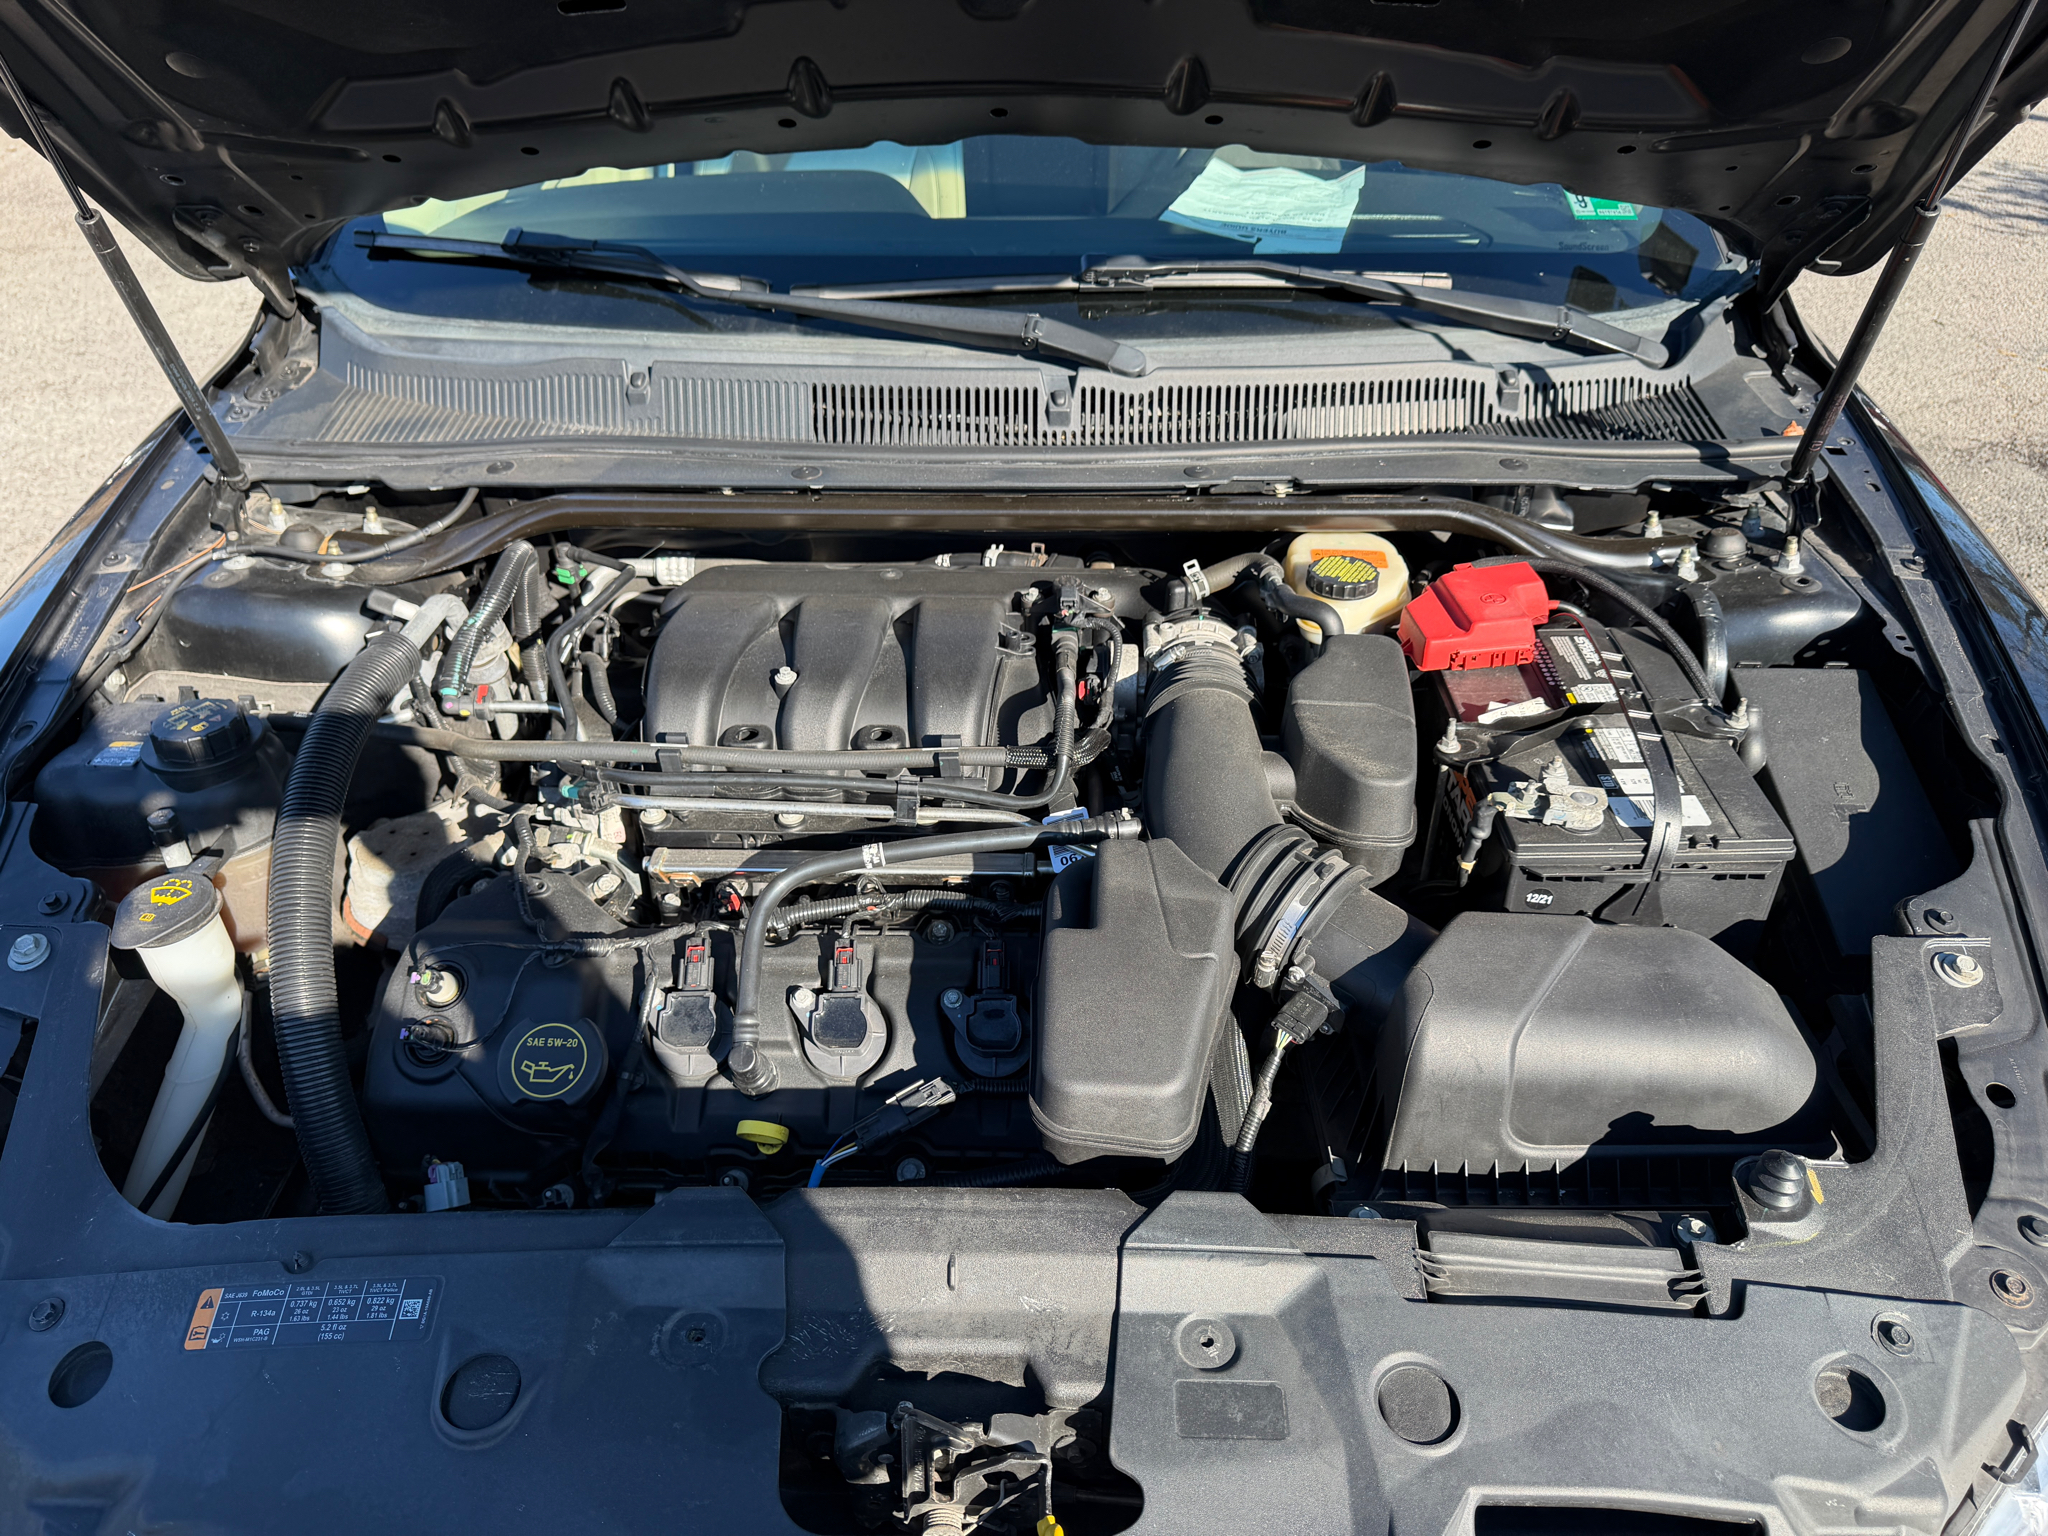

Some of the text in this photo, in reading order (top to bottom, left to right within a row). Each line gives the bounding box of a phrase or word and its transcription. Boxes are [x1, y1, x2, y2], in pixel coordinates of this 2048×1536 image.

[1558, 241, 1610, 252] SoundScreen
[1526, 892, 1554, 905] 12/21
[526, 1037, 579, 1048] SAE 5W-20
[252, 1288, 285, 1297] FoMoCo
[290, 1300, 318, 1308] 0.737 kg
[347, 1298, 356, 1306] kg
[385, 1297, 395, 1305] kg
[250, 1309, 276, 1317] R-134a
[320, 1323, 331, 1331] 5.2
[253, 1328, 270, 1336] PAG
[318, 1332, 345, 1342] (155 cc)
